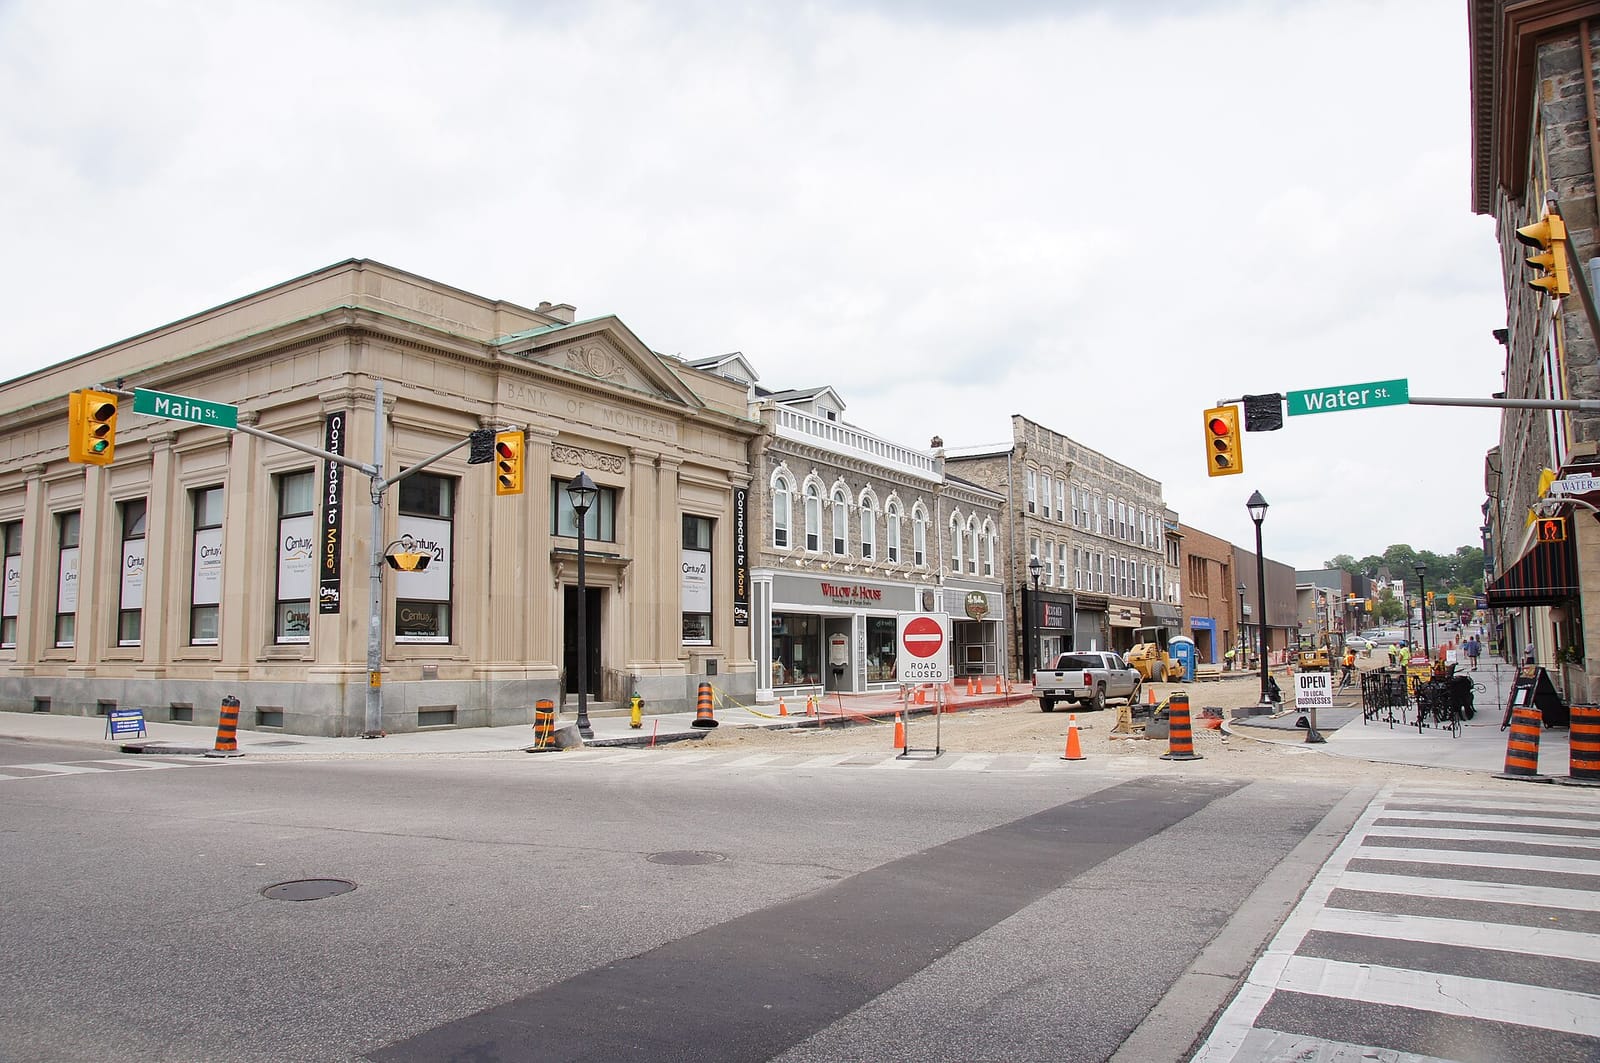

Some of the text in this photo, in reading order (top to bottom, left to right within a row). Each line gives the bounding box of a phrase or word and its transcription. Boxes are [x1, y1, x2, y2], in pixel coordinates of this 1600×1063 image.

[1303, 388, 1391, 411] Water St.
[155, 397, 219, 420] Main St.
[507, 383, 674, 439] BANK OF MONTREAL
[1561, 480, 1593, 491] WATER
[328, 508, 338, 525] to
[401, 534, 444, 562] Cntury 21
[737, 555, 744, 565] to
[821, 583, 881, 600] WILLOW HOUSE
[400, 608, 432, 622] Century
[910, 662, 937, 670] ROAD
[1300, 676, 1326, 688] OPEN
[1297, 697, 1331, 705] BUSINESSES
